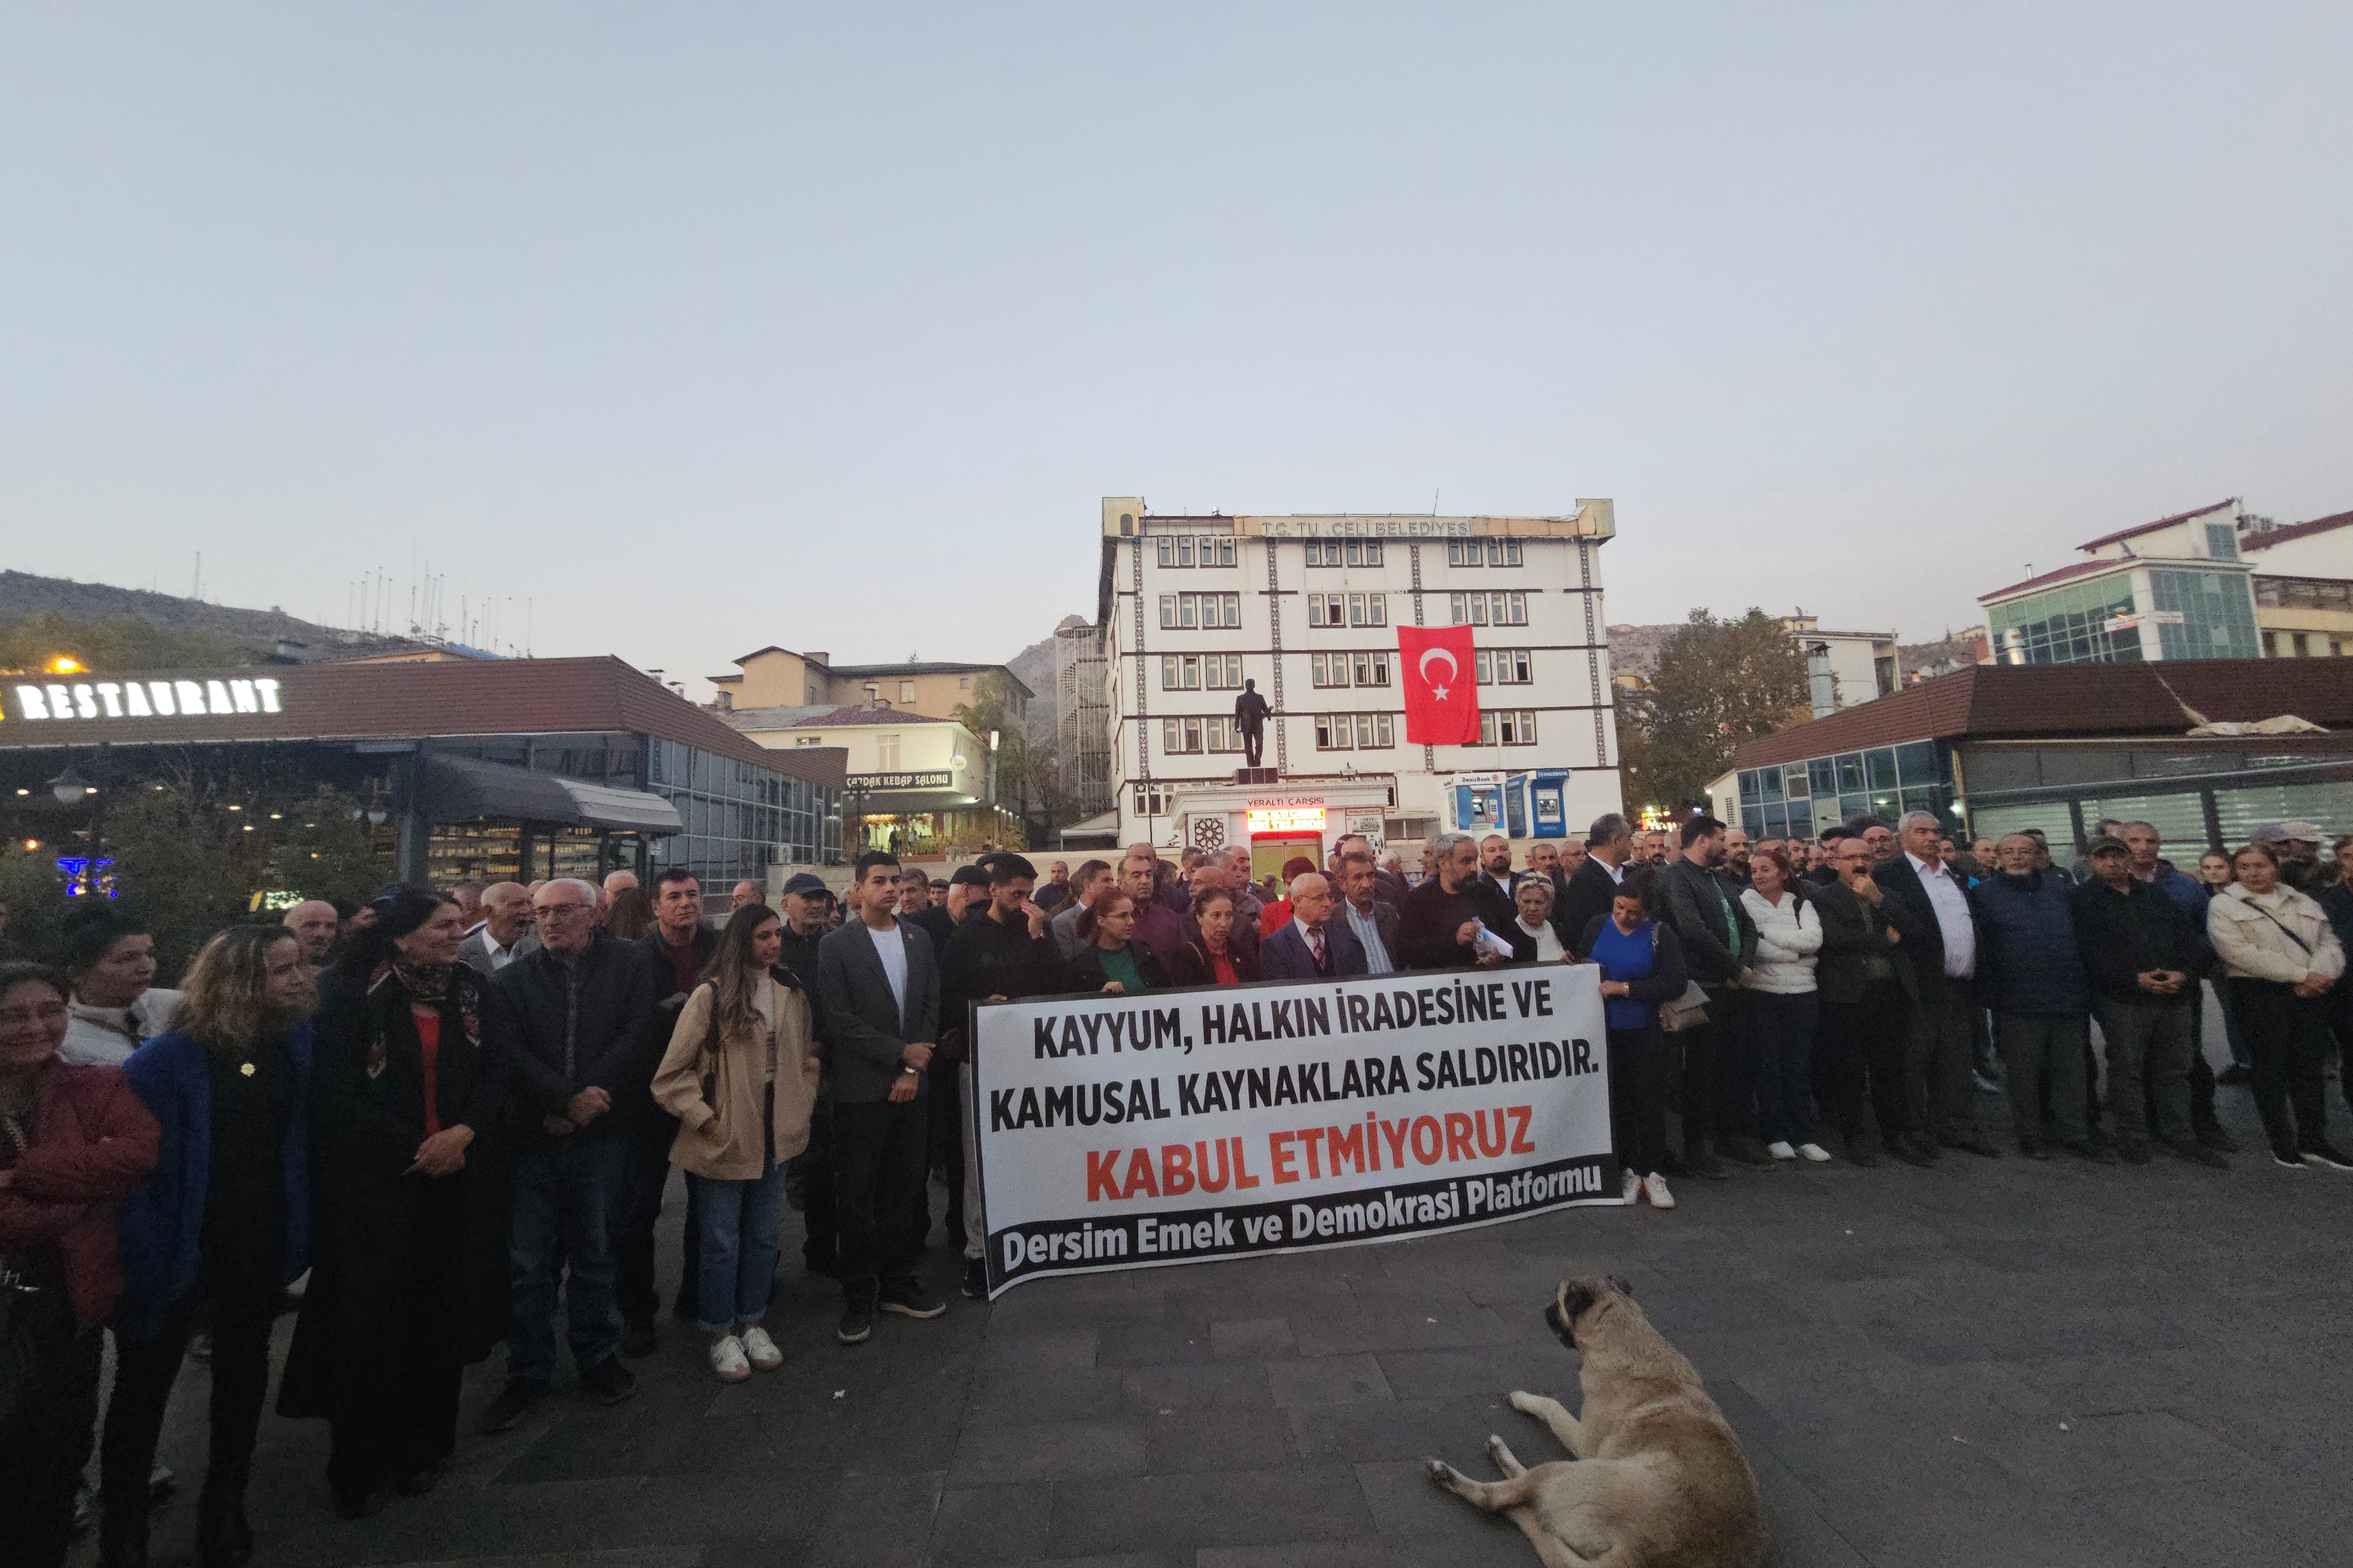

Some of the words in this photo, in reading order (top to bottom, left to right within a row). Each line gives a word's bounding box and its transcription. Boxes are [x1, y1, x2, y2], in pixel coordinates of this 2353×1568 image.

[15, 679, 281, 719] RESTAURANT
[884, 775, 912, 786] KEBAP
[915, 774, 949, 786] SALONU
[1247, 799, 1284, 807] YERALTI
[1288, 798, 1324, 806] ÇARŞISI
[1034, 1007, 1192, 1059] KAYYUM,
[1202, 997, 1331, 1045] HALKIN
[1336, 978, 1507, 1033] İRADESİNE
[1511, 979, 1554, 1018] VE
[991, 1077, 1171, 1132] KAMUSAL
[1177, 1055, 1411, 1116] KAYNAKLARA
[1416, 1039, 1599, 1091] SALDIRIDIR.
[1086, 1136, 1260, 1202] KABUL
[1269, 1105, 1535, 1185] ETMİYORUZ
[1004, 1222, 1128, 1273] Dersim
[1138, 1212, 1235, 1253] Emek
[1243, 1213, 1283, 1244] ve
[1292, 1183, 1459, 1239] Demokrasi
[1466, 1165, 1602, 1216] Platformu
